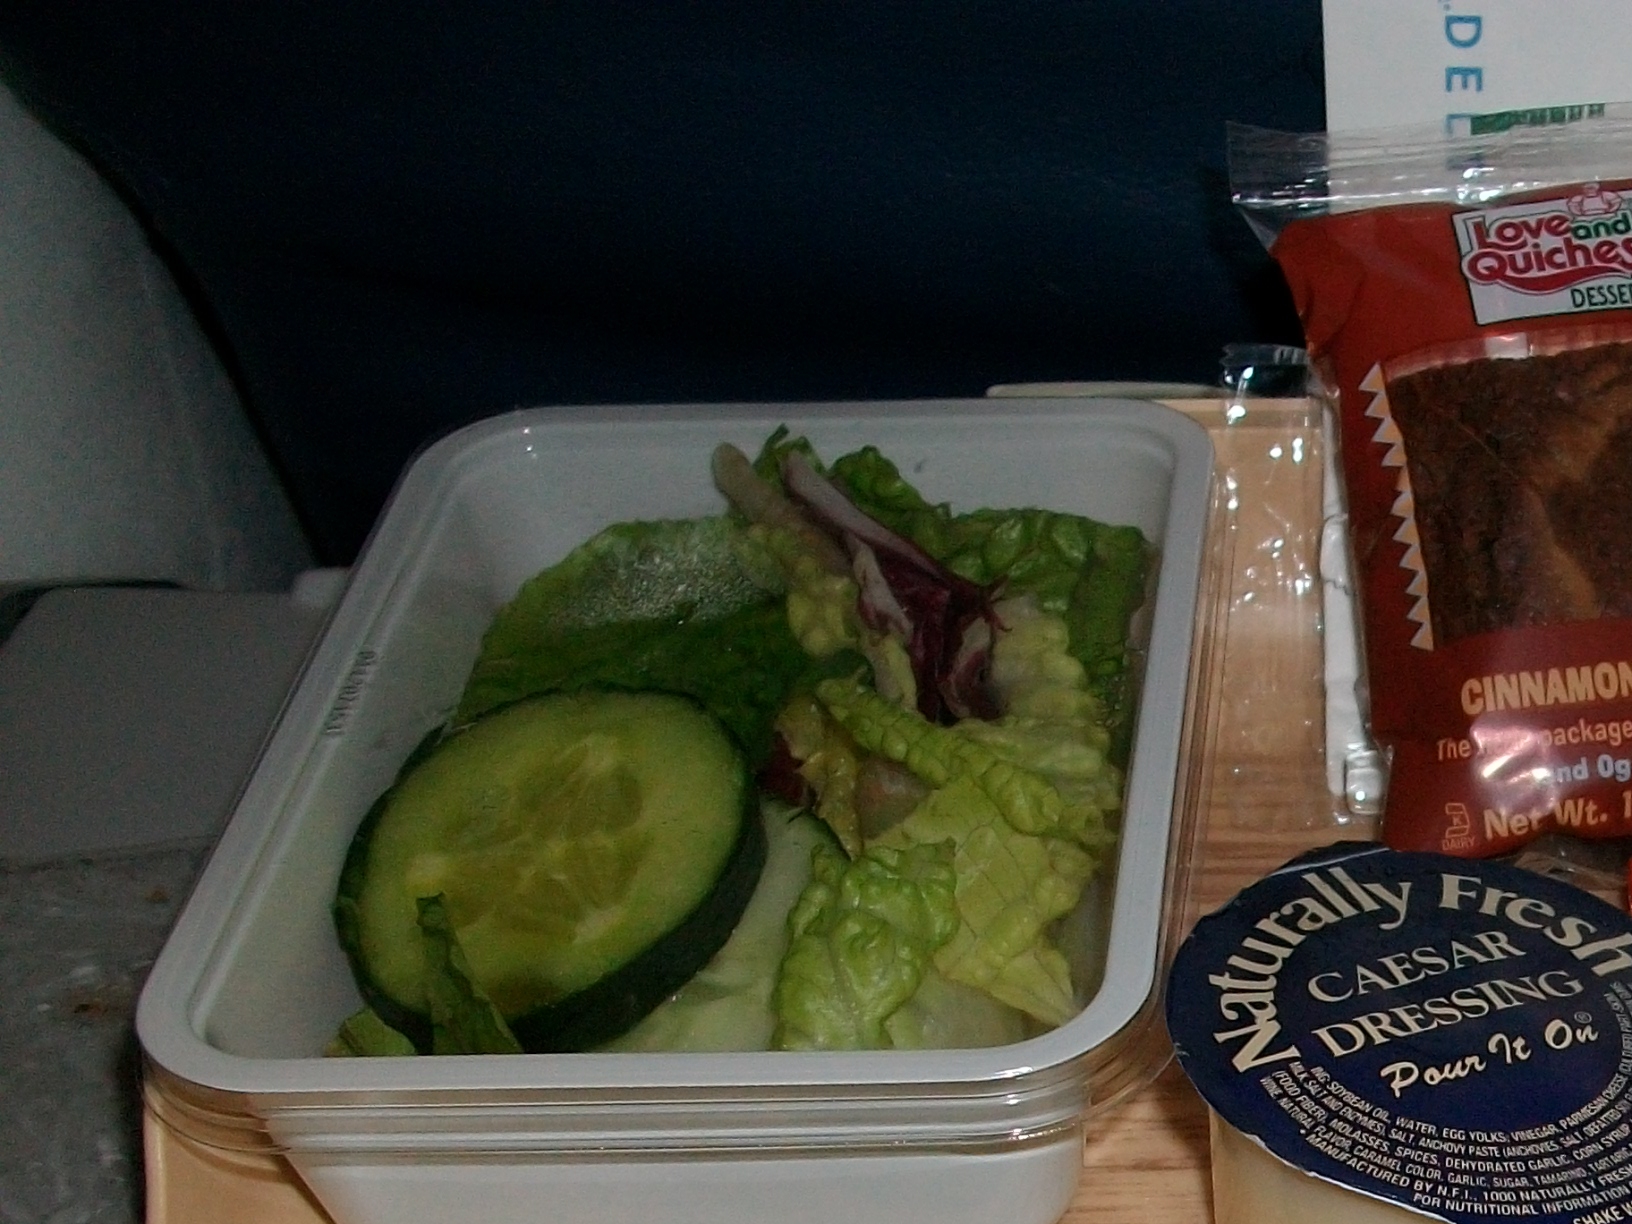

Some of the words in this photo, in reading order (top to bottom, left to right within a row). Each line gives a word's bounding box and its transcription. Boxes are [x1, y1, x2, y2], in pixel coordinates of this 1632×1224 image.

[1471, 213, 1572, 251] Love
[1570, 212, 1632, 241] and
[1436, 737, 1472, 762] The
[1441, 836, 1476, 852] DAIRY
[1483, 807, 1544, 842] Net
[1553, 797, 1608, 827] Wt.
[1207, 865, 1413, 1074] Naturally
[1307, 930, 1527, 1004] CAESAR
[1312, 969, 1585, 1058] DRESSING
[1380, 1054, 1486, 1099] Pour
[1490, 1032, 1532, 1067] It
[1546, 1017, 1600, 1051] On
[1271, 1070, 1301, 1097] (FOOD
[1445, 1157, 1526, 1173] DEHYDRATED
[1573, 1141, 1601, 1161] CORN
[1279, 1097, 1315, 1130] NATURAL
[1353, 1145, 1402, 1172] CARAMEL
[1323, 1094, 1343, 1112] AND
[1418, 1137, 1467, 1155] ANCHOVY
[1469, 1144, 1501, 1157] PASTE
[1583, 1108, 1622, 1139] DEFATTED
[1326, 1080, 1373, 1114] SOYBEAN
[1442, 1128, 1466, 1141] EGG
[1559, 1096, 1609, 1130] PARMESAN
[1305, 1133, 1411, 1188] MANUFACTURED
[1413, 1178, 1434, 1195] BY
[1483, 1190, 1516, 1203] 1000
[1519, 1179, 1599, 1202] NATURALLY
[1413, 1193, 1441, 1208] FOR
[1445, 1200, 1538, 1215] NUTRITIONAL
[1542, 1184, 1631, 1213] INFORMATION
